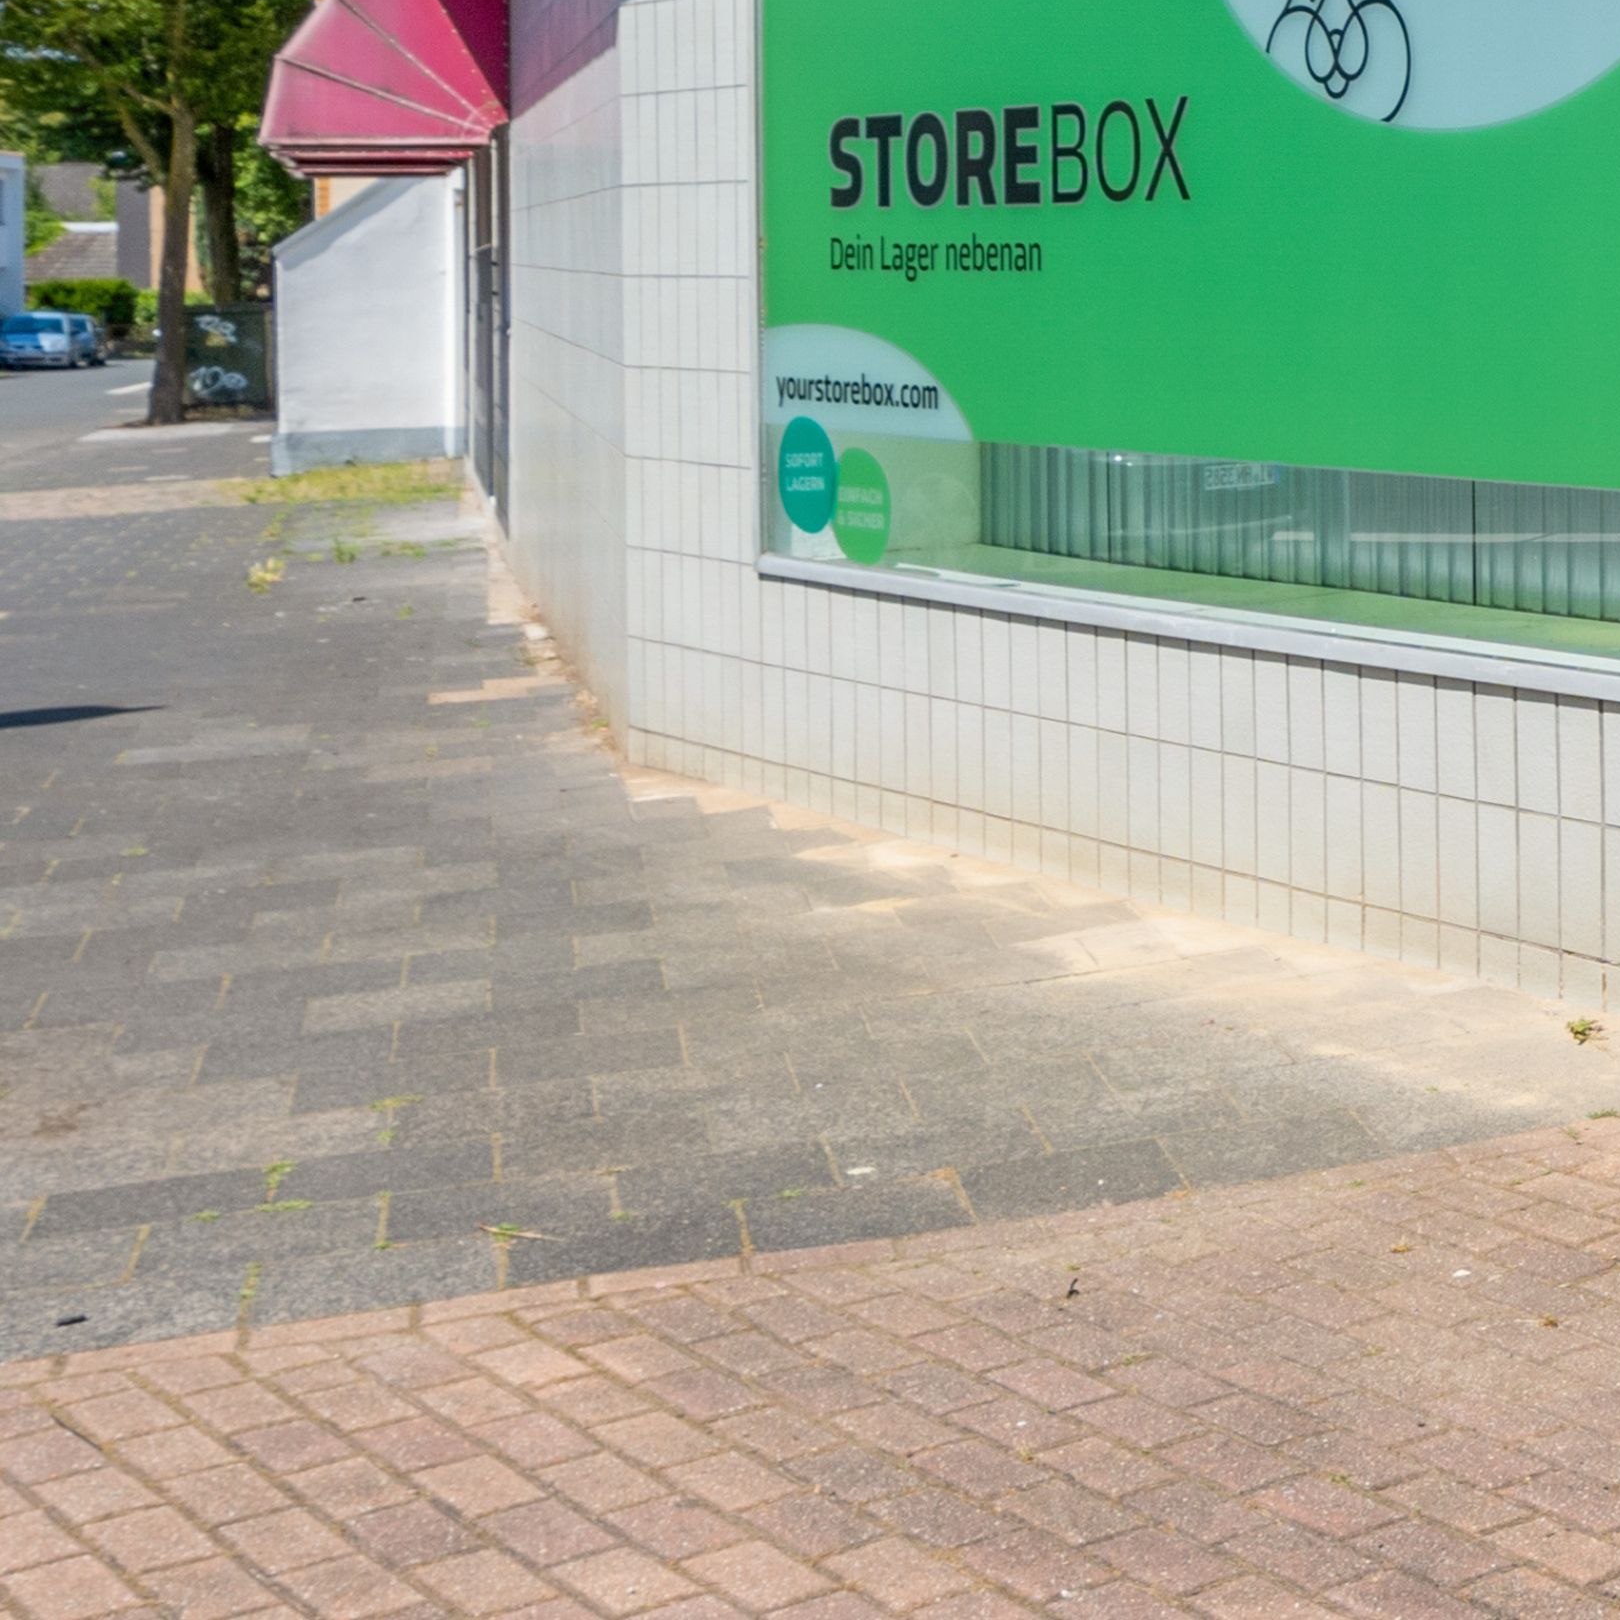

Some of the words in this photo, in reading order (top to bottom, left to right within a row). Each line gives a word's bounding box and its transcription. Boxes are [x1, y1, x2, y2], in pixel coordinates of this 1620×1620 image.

[829, 95, 1191, 209] STOREBOX
[830, 234, 873, 271] Dein
[880, 236, 938, 281] Lager
[945, 233, 1042, 272] nebenan
[776, 373, 938, 410] yourstorebox.com
[785, 452, 823, 468] SOFORT
[786, 476, 825, 492] LAGERN
